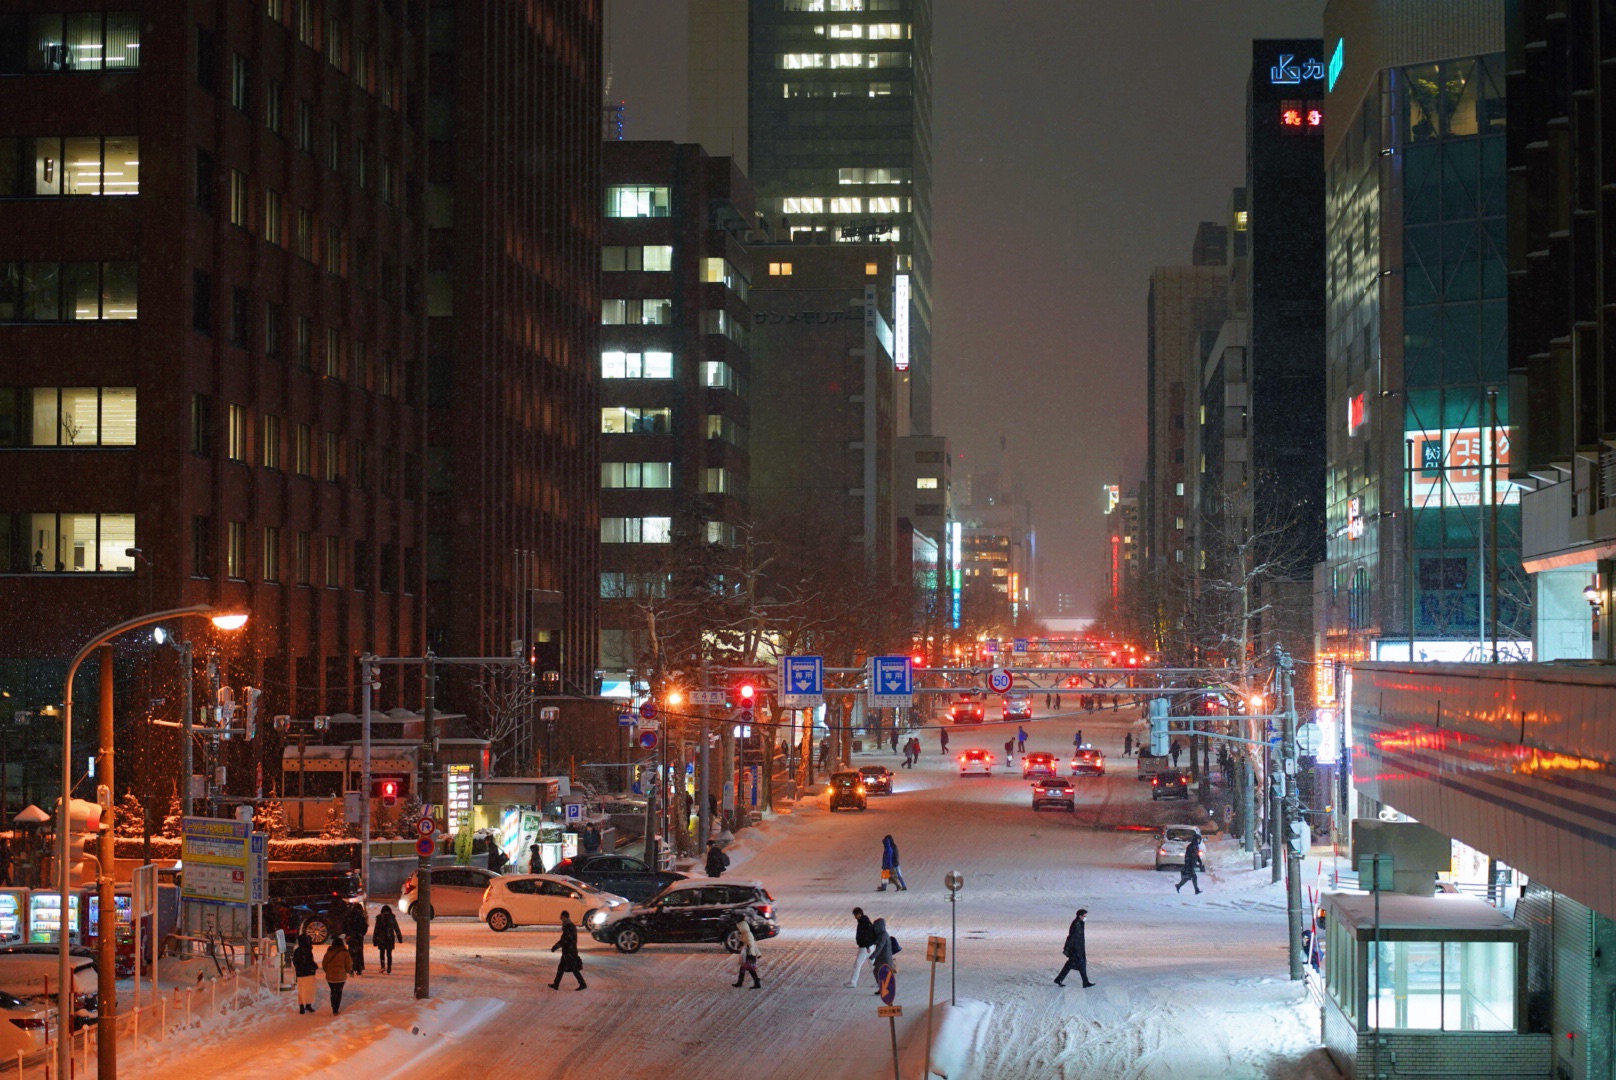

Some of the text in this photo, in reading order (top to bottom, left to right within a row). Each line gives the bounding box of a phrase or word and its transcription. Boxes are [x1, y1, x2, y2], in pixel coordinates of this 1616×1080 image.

[754, 310, 844, 325] サンメモリア
[1456, 436, 1510, 456] コミク
[795, 671, 813, 679] 専用
[885, 672, 903, 680] 専用
[994, 675, 1008, 687] 50
[570, 806, 577, 816] P
